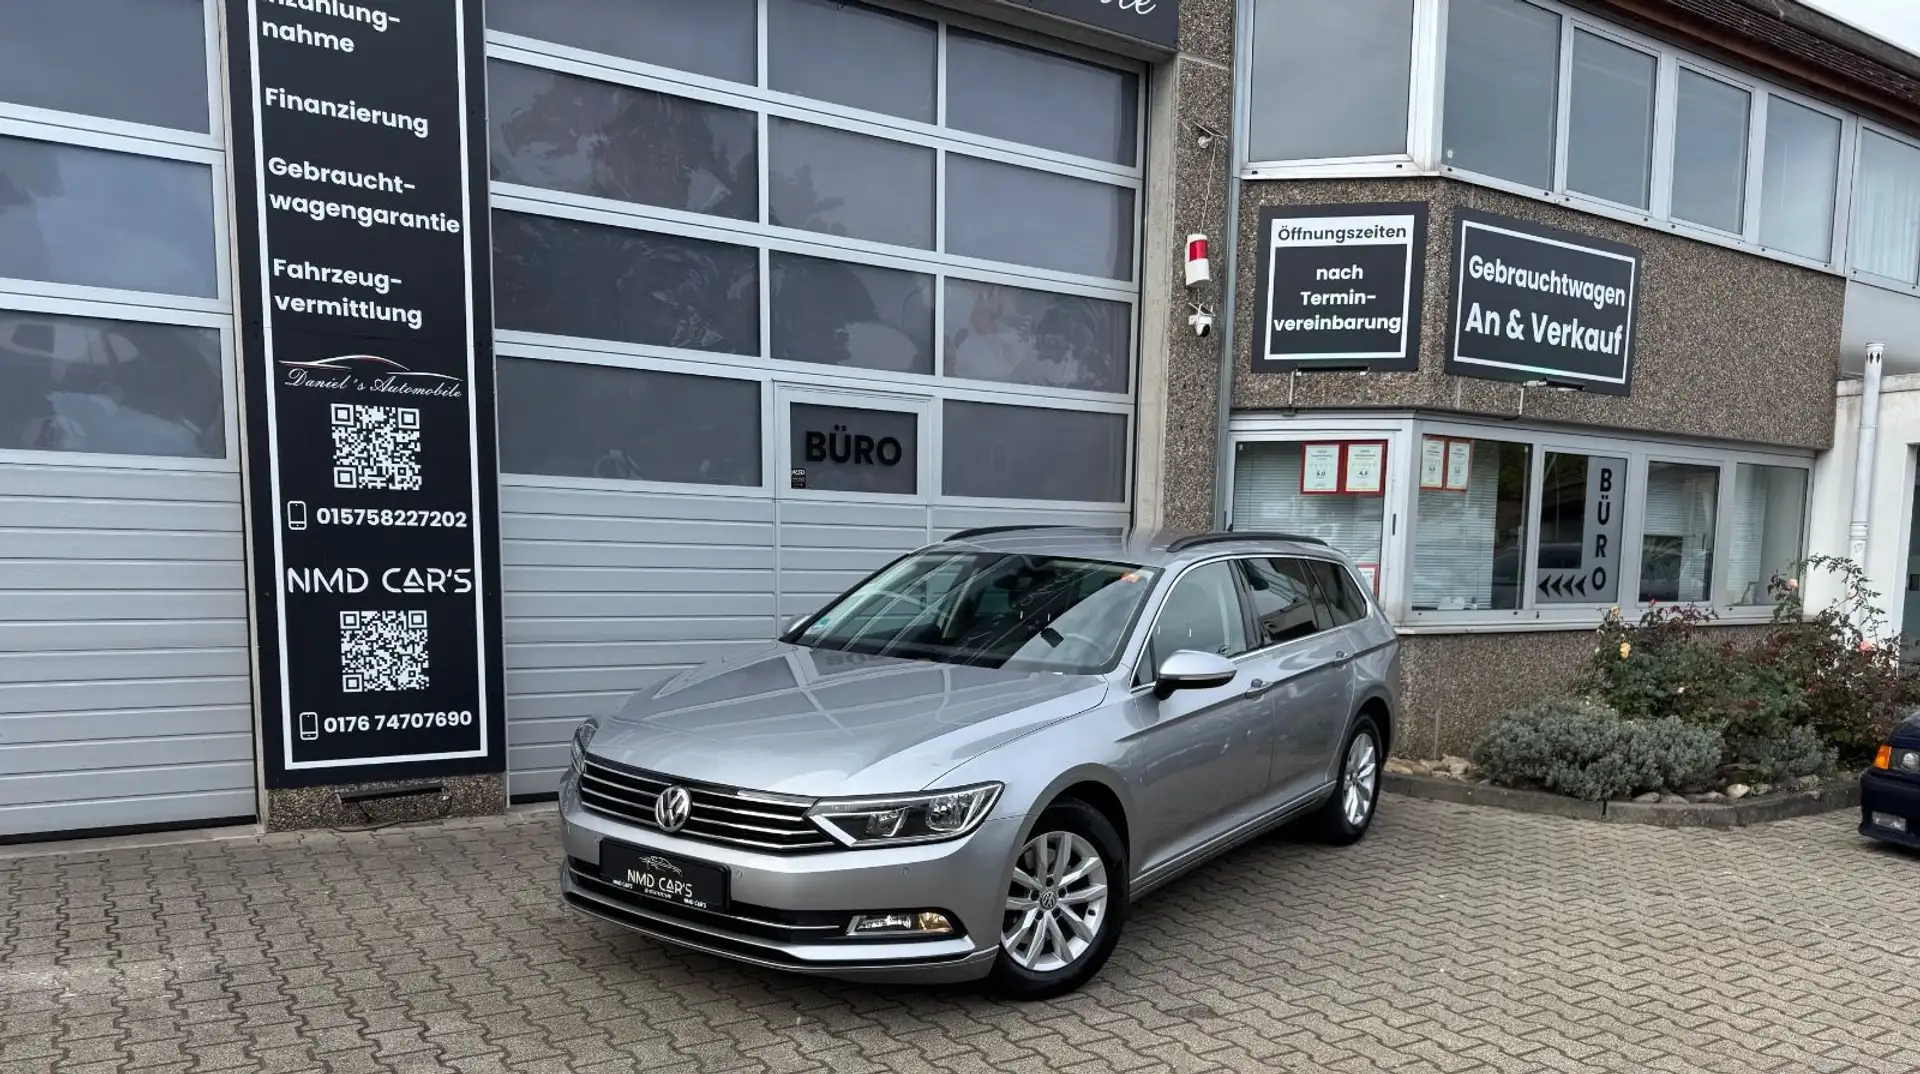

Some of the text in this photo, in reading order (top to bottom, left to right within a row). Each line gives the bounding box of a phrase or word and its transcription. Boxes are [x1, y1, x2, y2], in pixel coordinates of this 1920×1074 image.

[262, 0, 401, 34] zahlung-
[262, 19, 356, 53] nahme
[265, 87, 429, 139] Finanzierung
[268, 156, 416, 194] Gebraucht-
[269, 190, 460, 233] wagengarantie
[1278, 224, 1407, 244] Öffnungszeiten
[273, 258, 402, 295] Fahrzeug-
[1316, 264, 1364, 281] nach
[1468, 254, 1626, 310] Gebrauchtwagen
[274, 292, 423, 330] vermittlung
[1300, 288, 1377, 306] Termin-
[1273, 314, 1402, 334] vereinbarung
[1464, 302, 1624, 356] An & Verkauf
[369, 373, 463, 397] Automobile
[805, 423, 903, 467] BÜRO
[316, 507, 467, 528] 015758227202
[1591, 467, 1613, 591] BÜRO
[287, 567, 472, 593] NMD CAR'S
[323, 710, 472, 733] 0176 74707690
[627, 868, 655, 888] NMD
[658, 877, 693, 898] CAR'S
